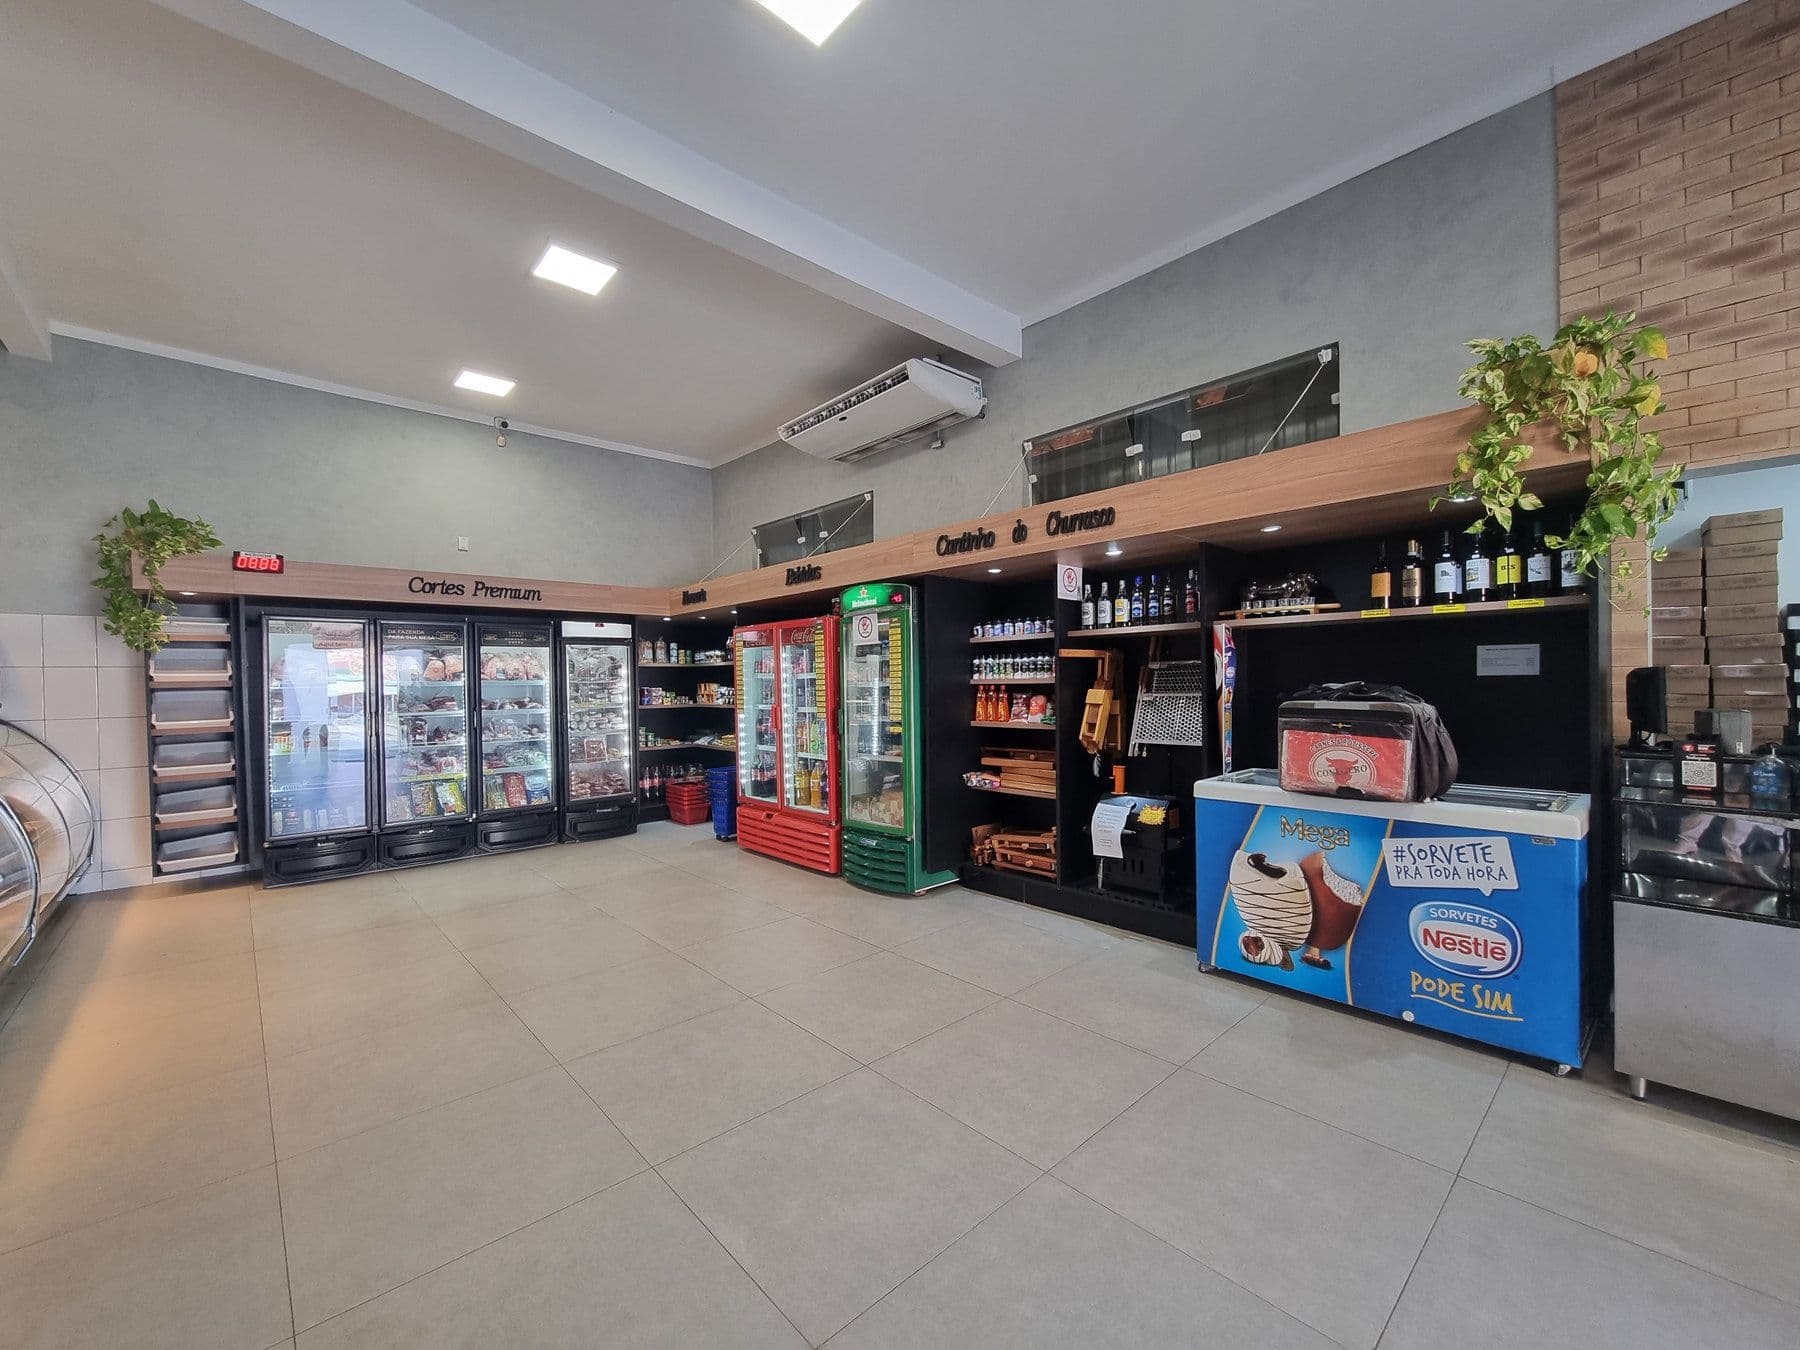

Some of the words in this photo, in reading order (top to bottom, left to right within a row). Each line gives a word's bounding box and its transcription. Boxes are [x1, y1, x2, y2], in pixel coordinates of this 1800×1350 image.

[936, 526, 996, 557] Cantinho
[1012, 519, 1028, 543] do
[1046, 506, 1116, 536] Churrasco
[408, 576, 466, 596] Cortes
[472, 580, 543, 601] Premium
[1280, 815, 1350, 850] Mega
[1393, 842, 1495, 865] #SORVETE
[1396, 866, 1423, 881] PRA
[1426, 865, 1459, 881] TODA
[1466, 865, 1509, 882] HORA
[1429, 907, 1498, 929] SORVETES
[1410, 971, 1465, 1003] PODE
[1472, 984, 1514, 1015] SIM
